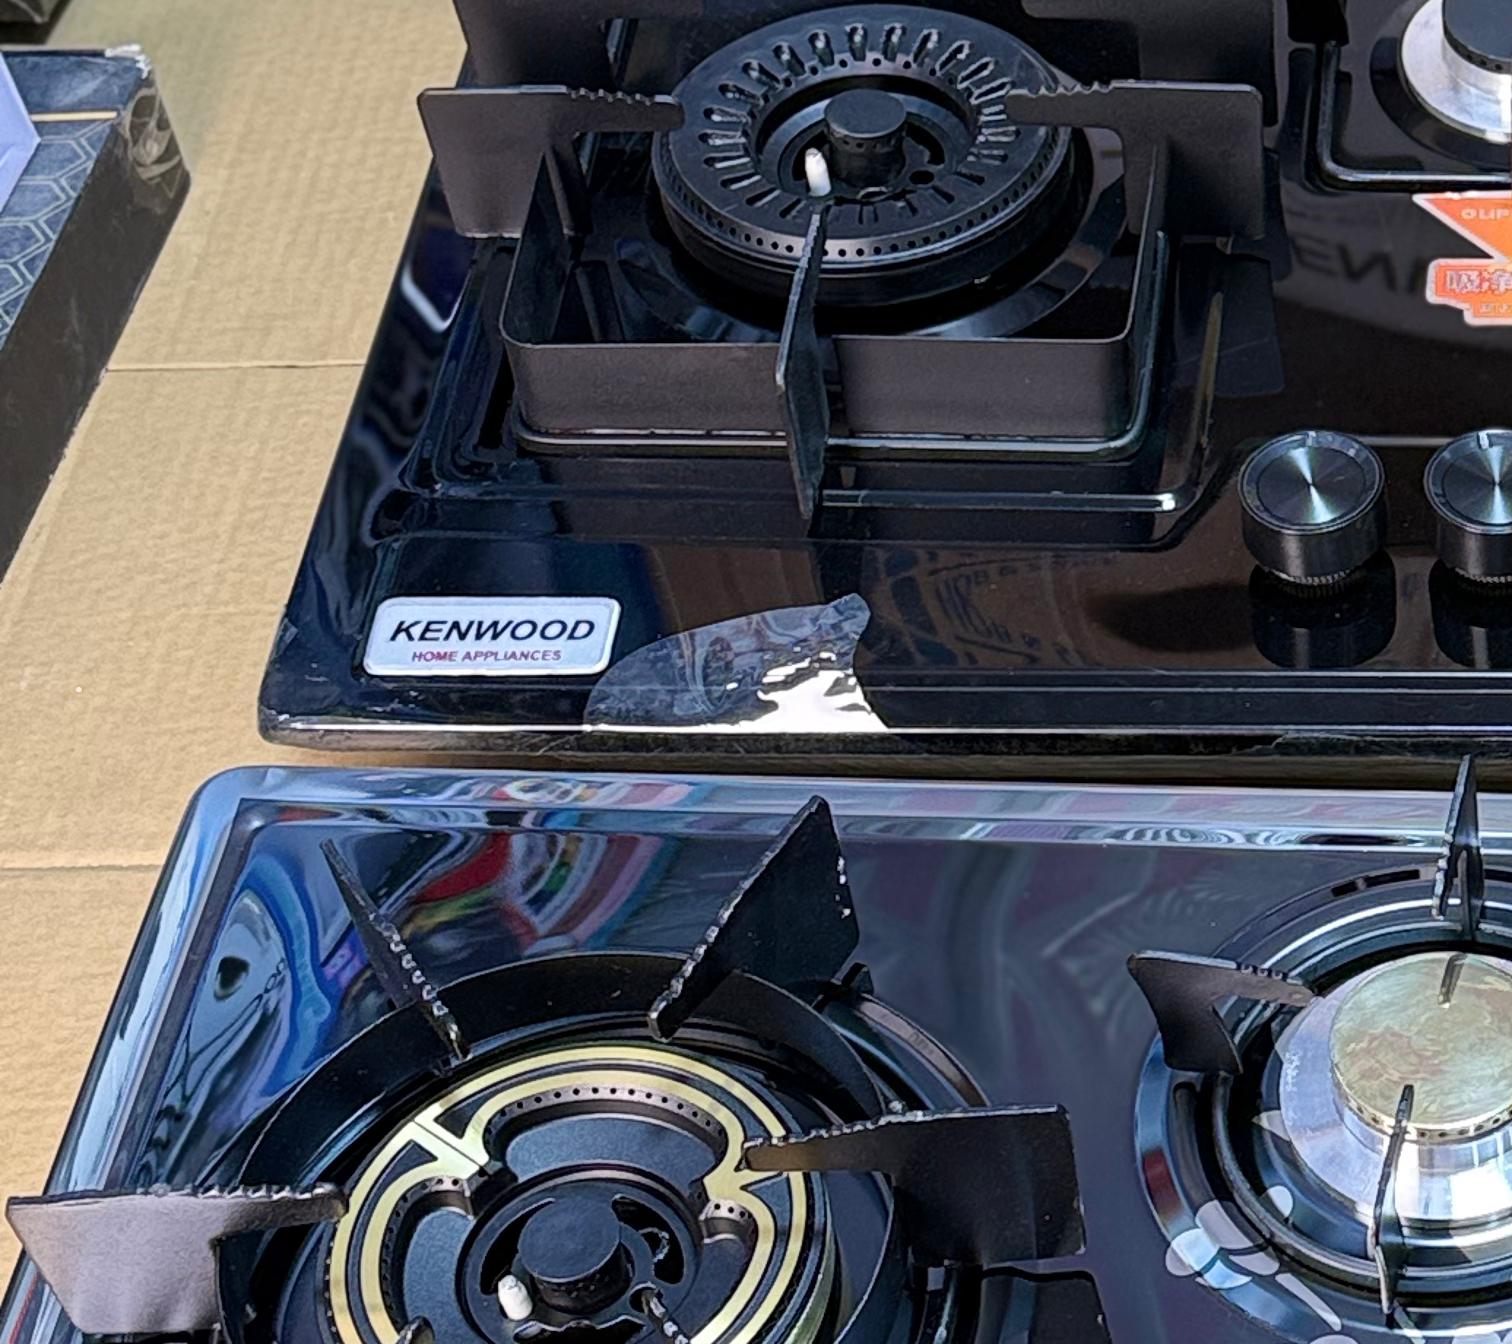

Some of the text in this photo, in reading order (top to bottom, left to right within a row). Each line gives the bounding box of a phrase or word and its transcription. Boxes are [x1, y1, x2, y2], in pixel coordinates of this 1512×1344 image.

[389, 619, 595, 642] KENWOOD
[411, 649, 562, 663] HOME APPLIANCES
